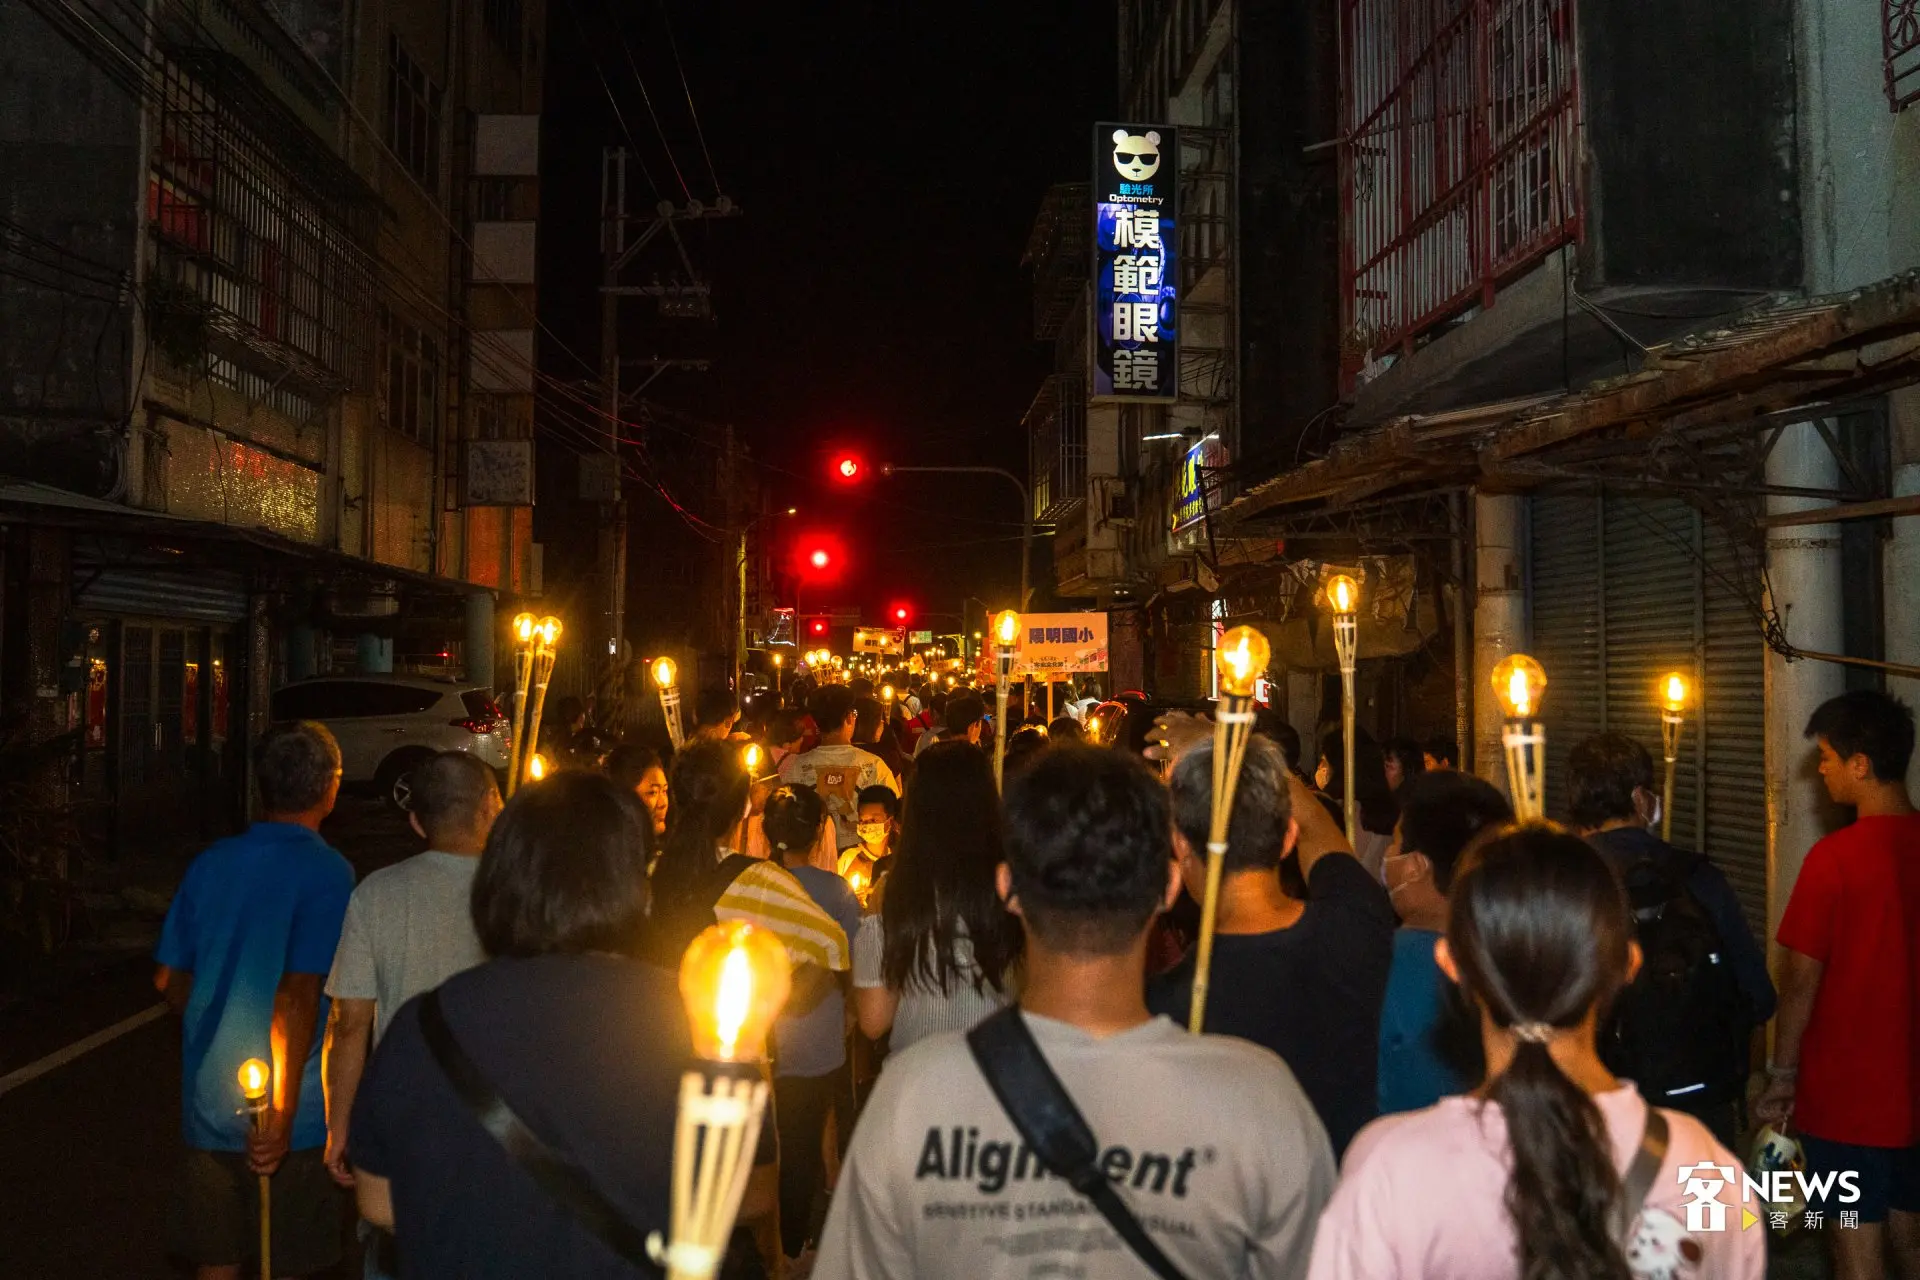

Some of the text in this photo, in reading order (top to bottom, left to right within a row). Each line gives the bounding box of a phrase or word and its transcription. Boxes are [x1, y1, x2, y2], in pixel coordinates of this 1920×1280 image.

[1119, 183, 1154, 195] 驗光所
[1109, 193, 1164, 205] Optometry
[1113, 208, 1160, 390] 模範眼鏡
[1029, 627, 1095, 644] 陽明國小
[916, 1126, 1196, 1198] Alignent
